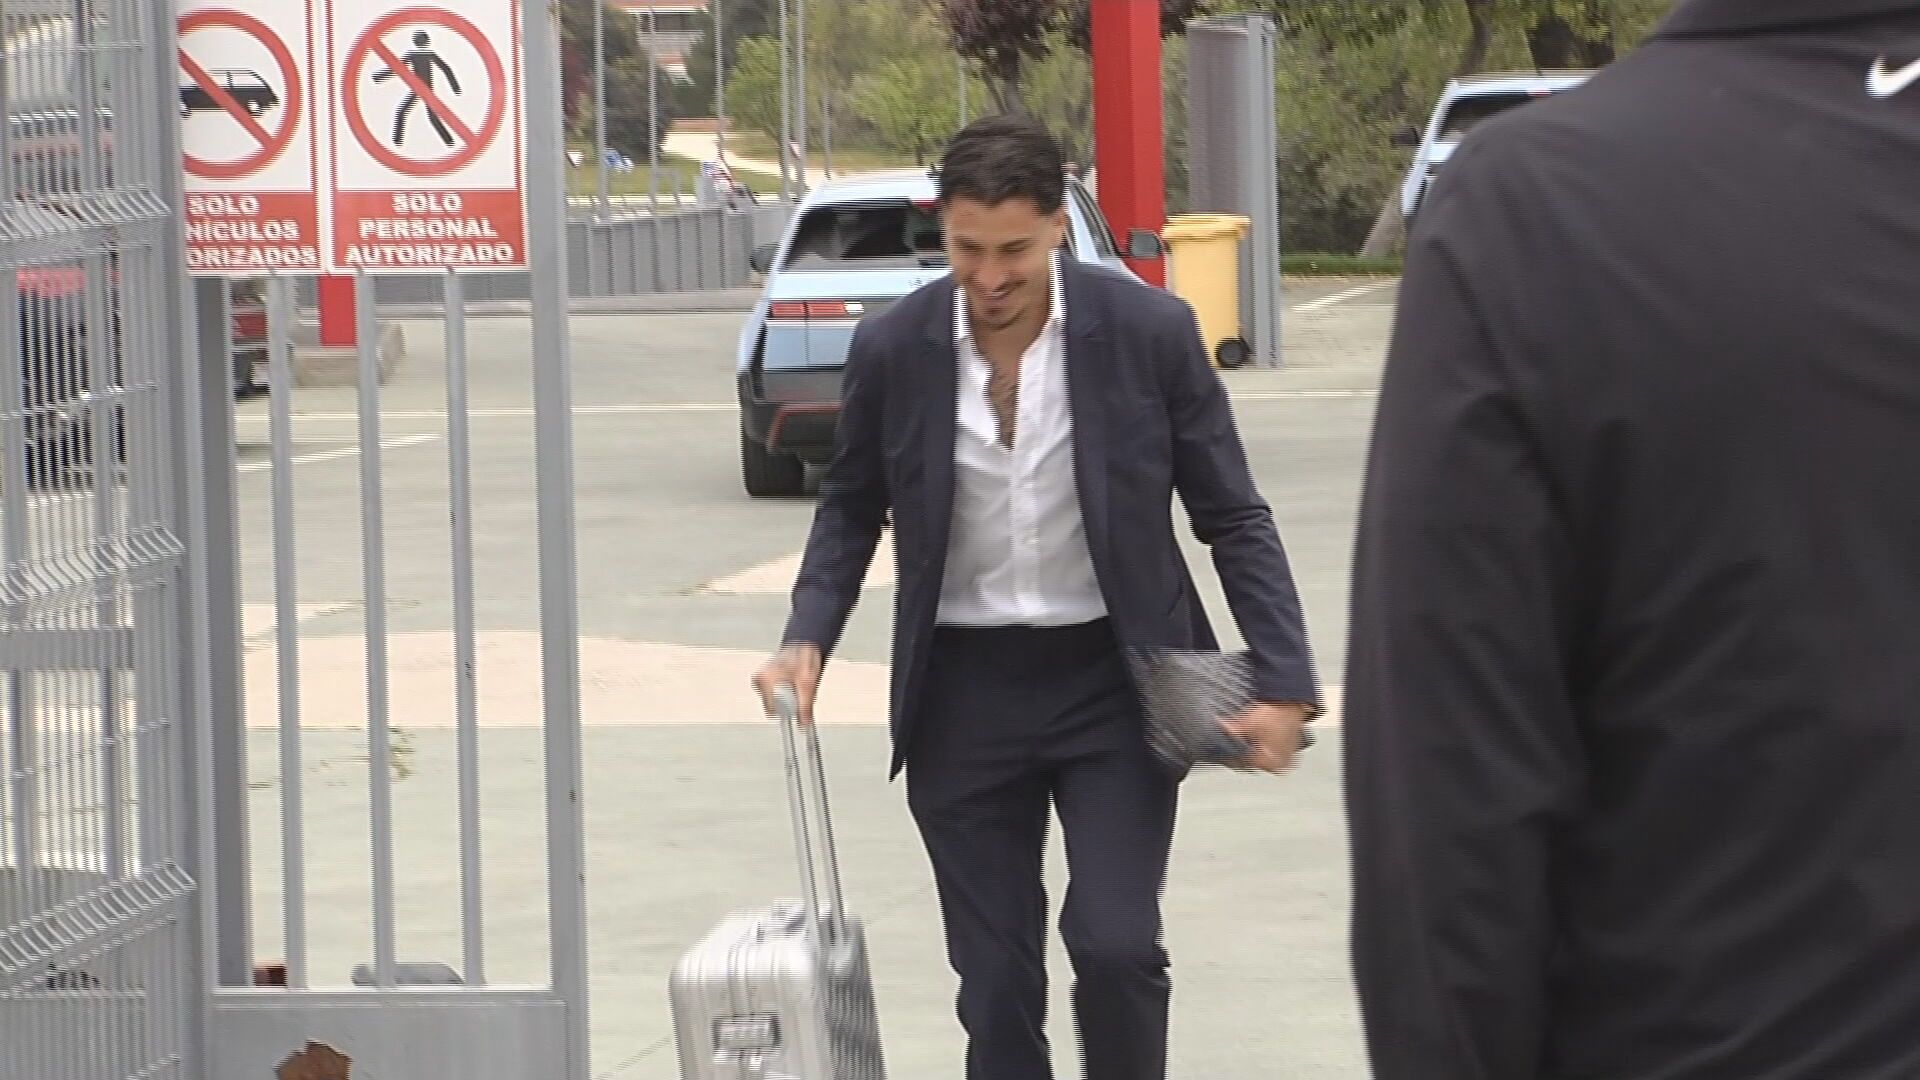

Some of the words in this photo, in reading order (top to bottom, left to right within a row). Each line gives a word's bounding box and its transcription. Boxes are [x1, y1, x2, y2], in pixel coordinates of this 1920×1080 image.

[188, 195, 260, 216] SOLO
[392, 193, 463, 213] SOLO
[360, 218, 498, 239] PERSONAL
[345, 244, 514, 265] AUTORIZADO
